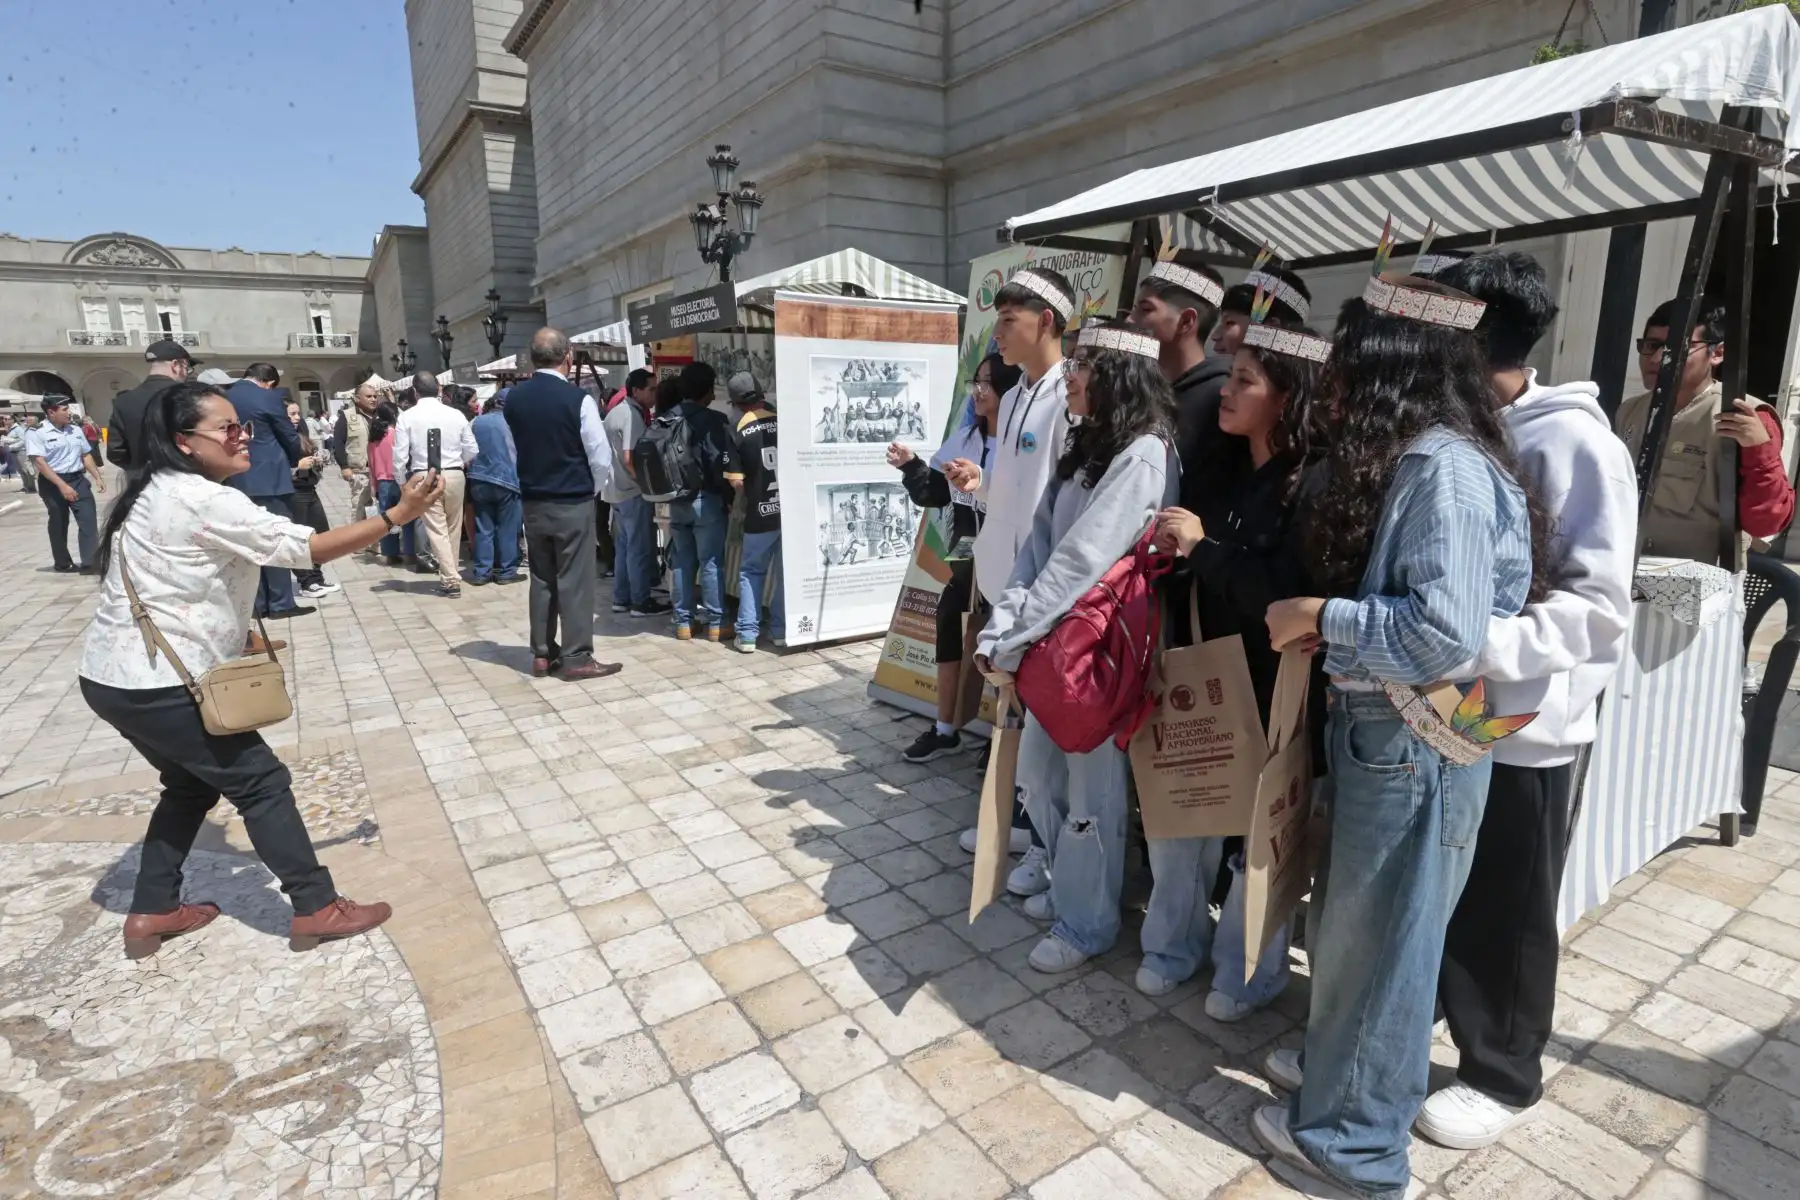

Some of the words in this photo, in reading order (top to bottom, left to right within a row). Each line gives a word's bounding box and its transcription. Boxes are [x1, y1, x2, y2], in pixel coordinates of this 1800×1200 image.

[670, 302, 686, 316] MUSEO
[687, 296, 716, 313] ELECTORAL
[680, 315, 687, 326] LA
[687, 308, 720, 325] DEMOCRACIA
[1152, 722, 1164, 752] V
[1164, 716, 1217, 731] CONGRESO
[1166, 727, 1214, 741] NACIONAL
[1168, 732, 1234, 750] AFROPERUANO
